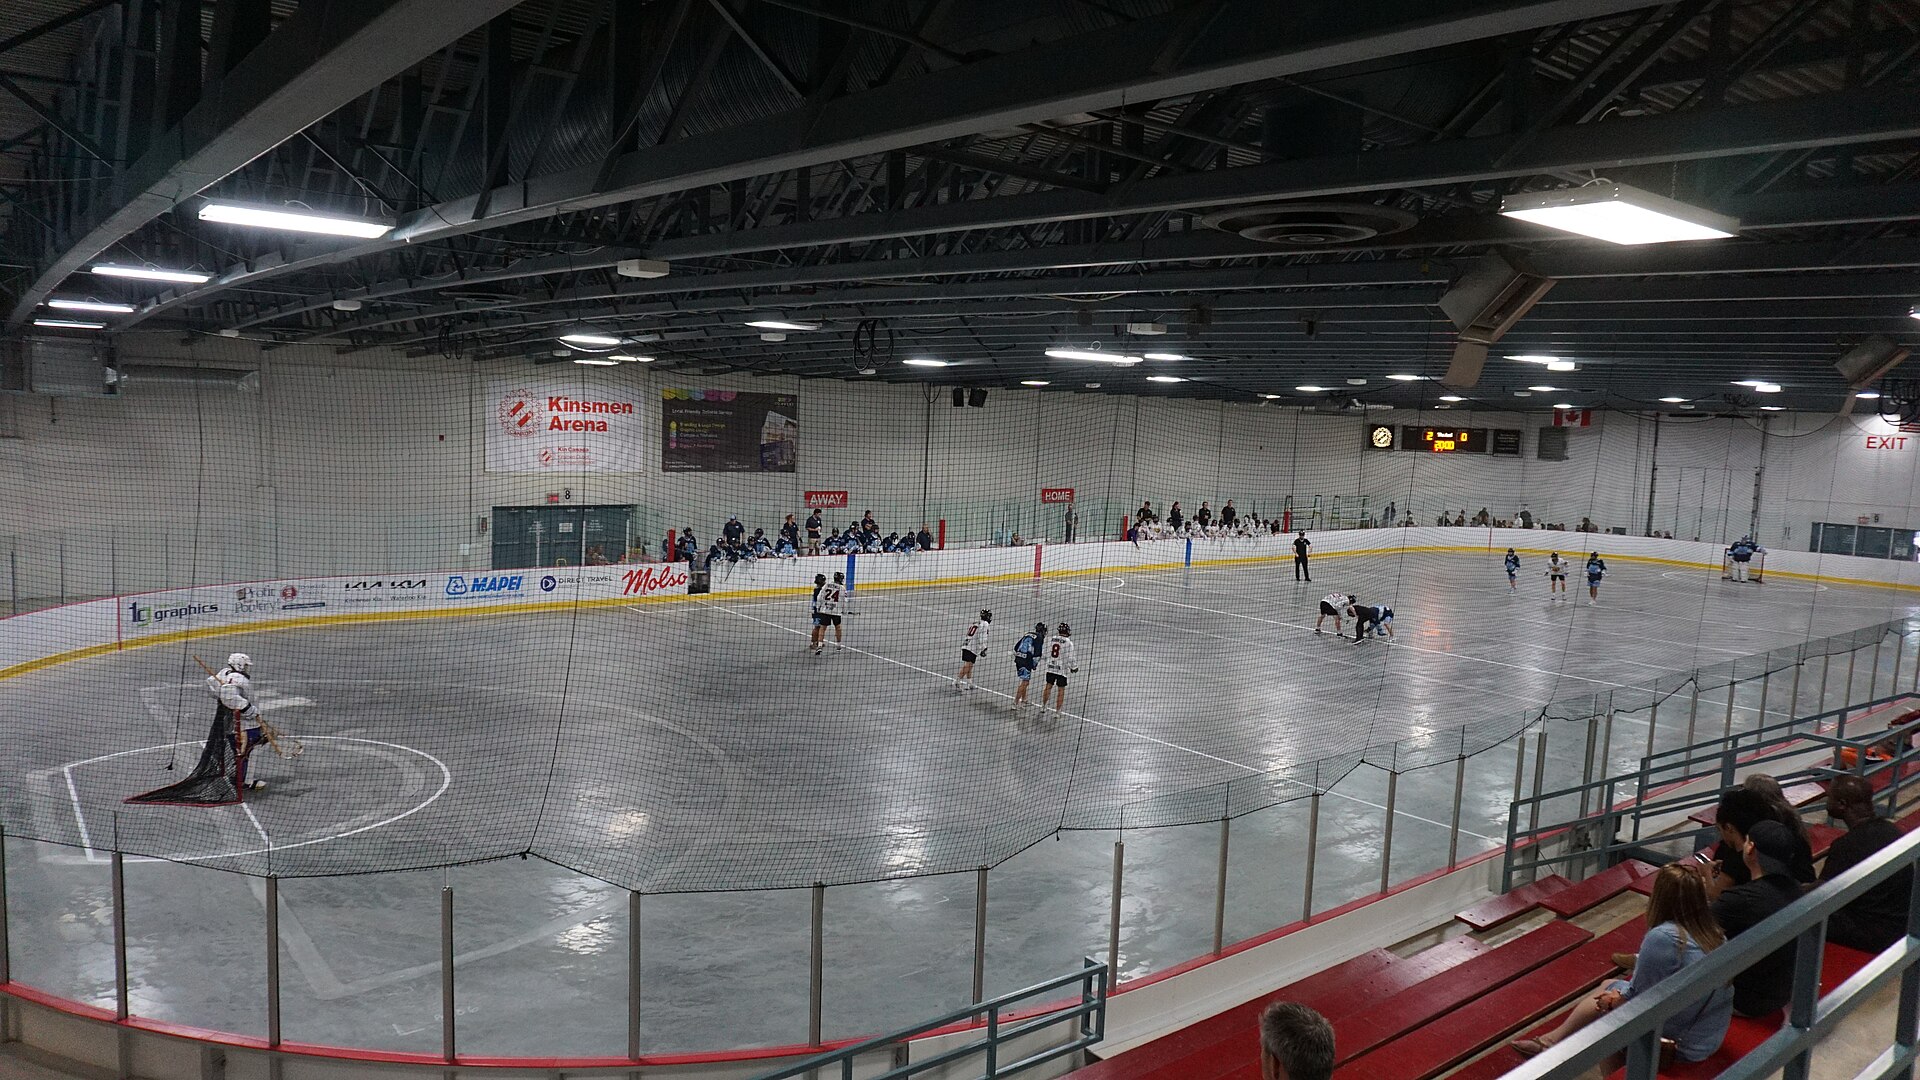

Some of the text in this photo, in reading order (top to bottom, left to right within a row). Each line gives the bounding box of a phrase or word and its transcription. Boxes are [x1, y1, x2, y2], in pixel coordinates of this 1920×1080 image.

[548, 396, 633, 415] Kinsmen
[548, 415, 608, 433] Arena
[1426, 431, 1434, 441] 2
[1460, 433, 1468, 442] 0
[1866, 436, 1908, 450] EXIT
[564, 489, 571, 500] 8
[810, 494, 843, 505] AWAY
[1045, 491, 1070, 501] HOME
[471, 576, 523, 593] MAPEI
[558, 575, 613, 585] DIRECT TRAVEL
[824, 588, 840, 603] 24
[154, 604, 219, 622] graphics
[1051, 643, 1061, 659] 8
